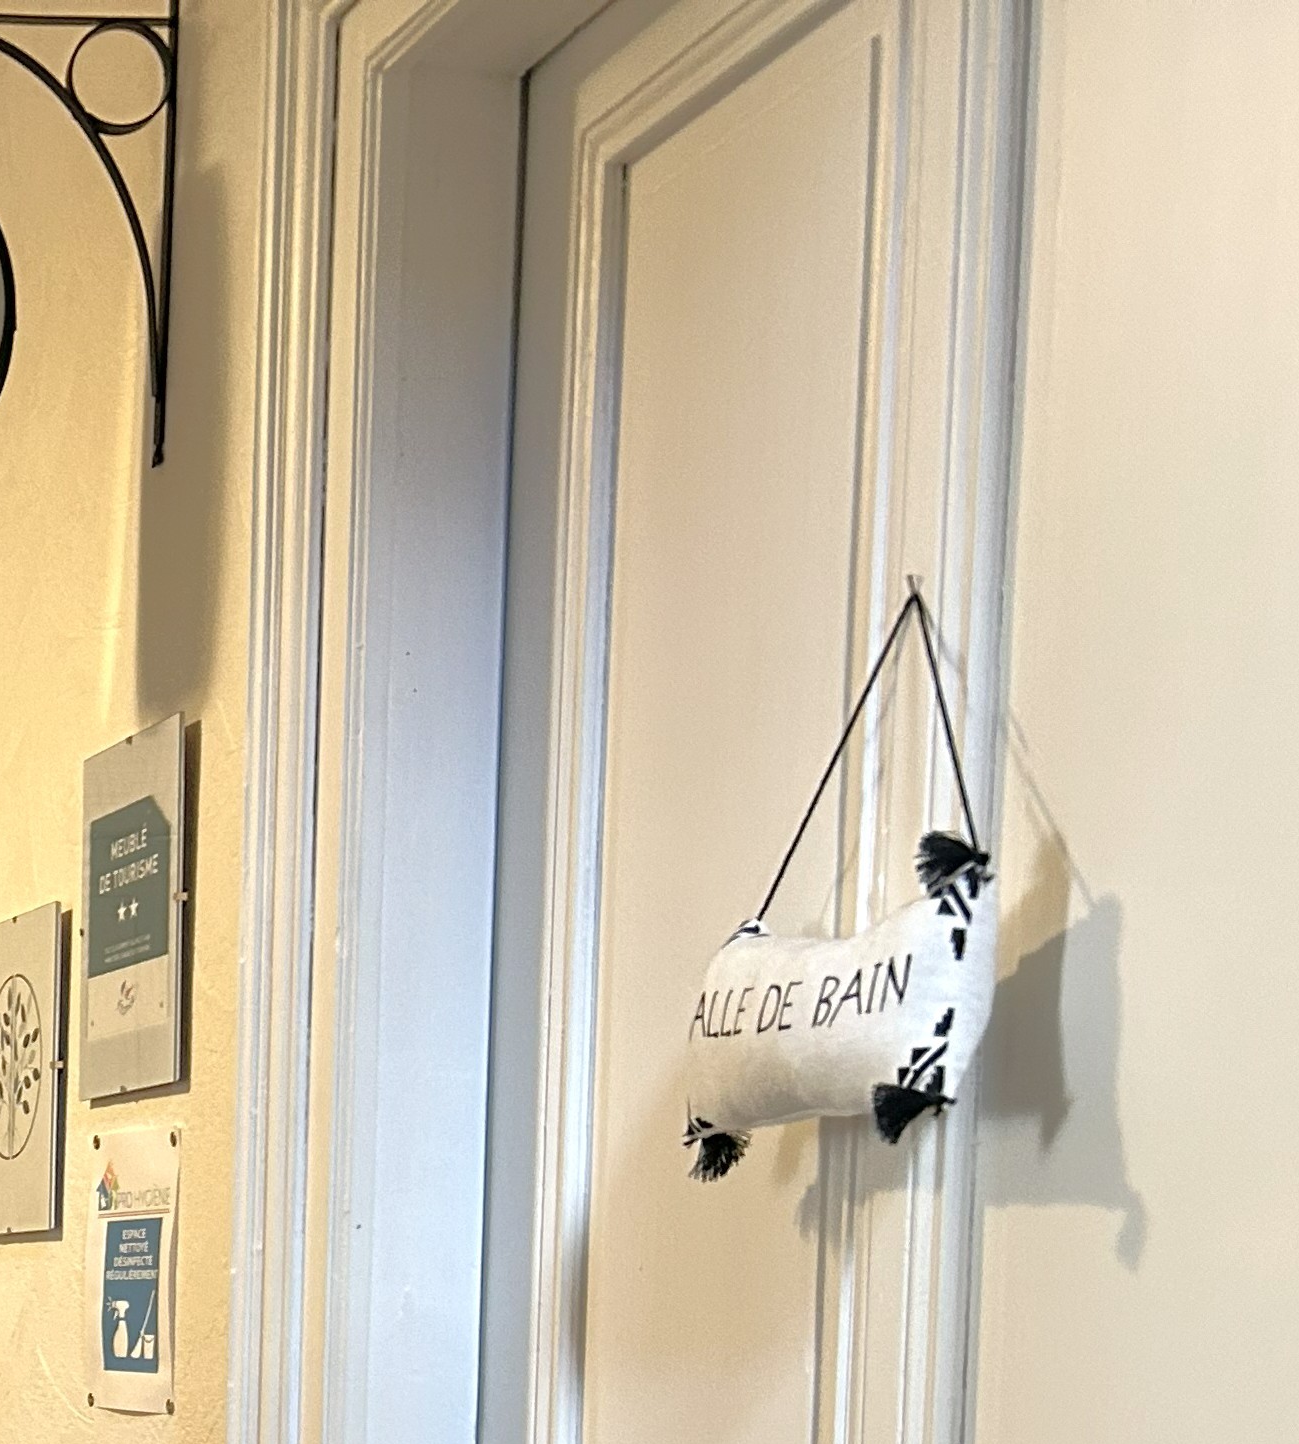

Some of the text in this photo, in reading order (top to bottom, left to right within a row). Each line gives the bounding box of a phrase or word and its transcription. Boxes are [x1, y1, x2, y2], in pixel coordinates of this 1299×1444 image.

[110, 822, 148, 861] MEUBLÉ
[99, 853, 159, 895] DE TOURISME
[756, 980, 803, 1034] DE
[812, 953, 913, 1029] BAIN
